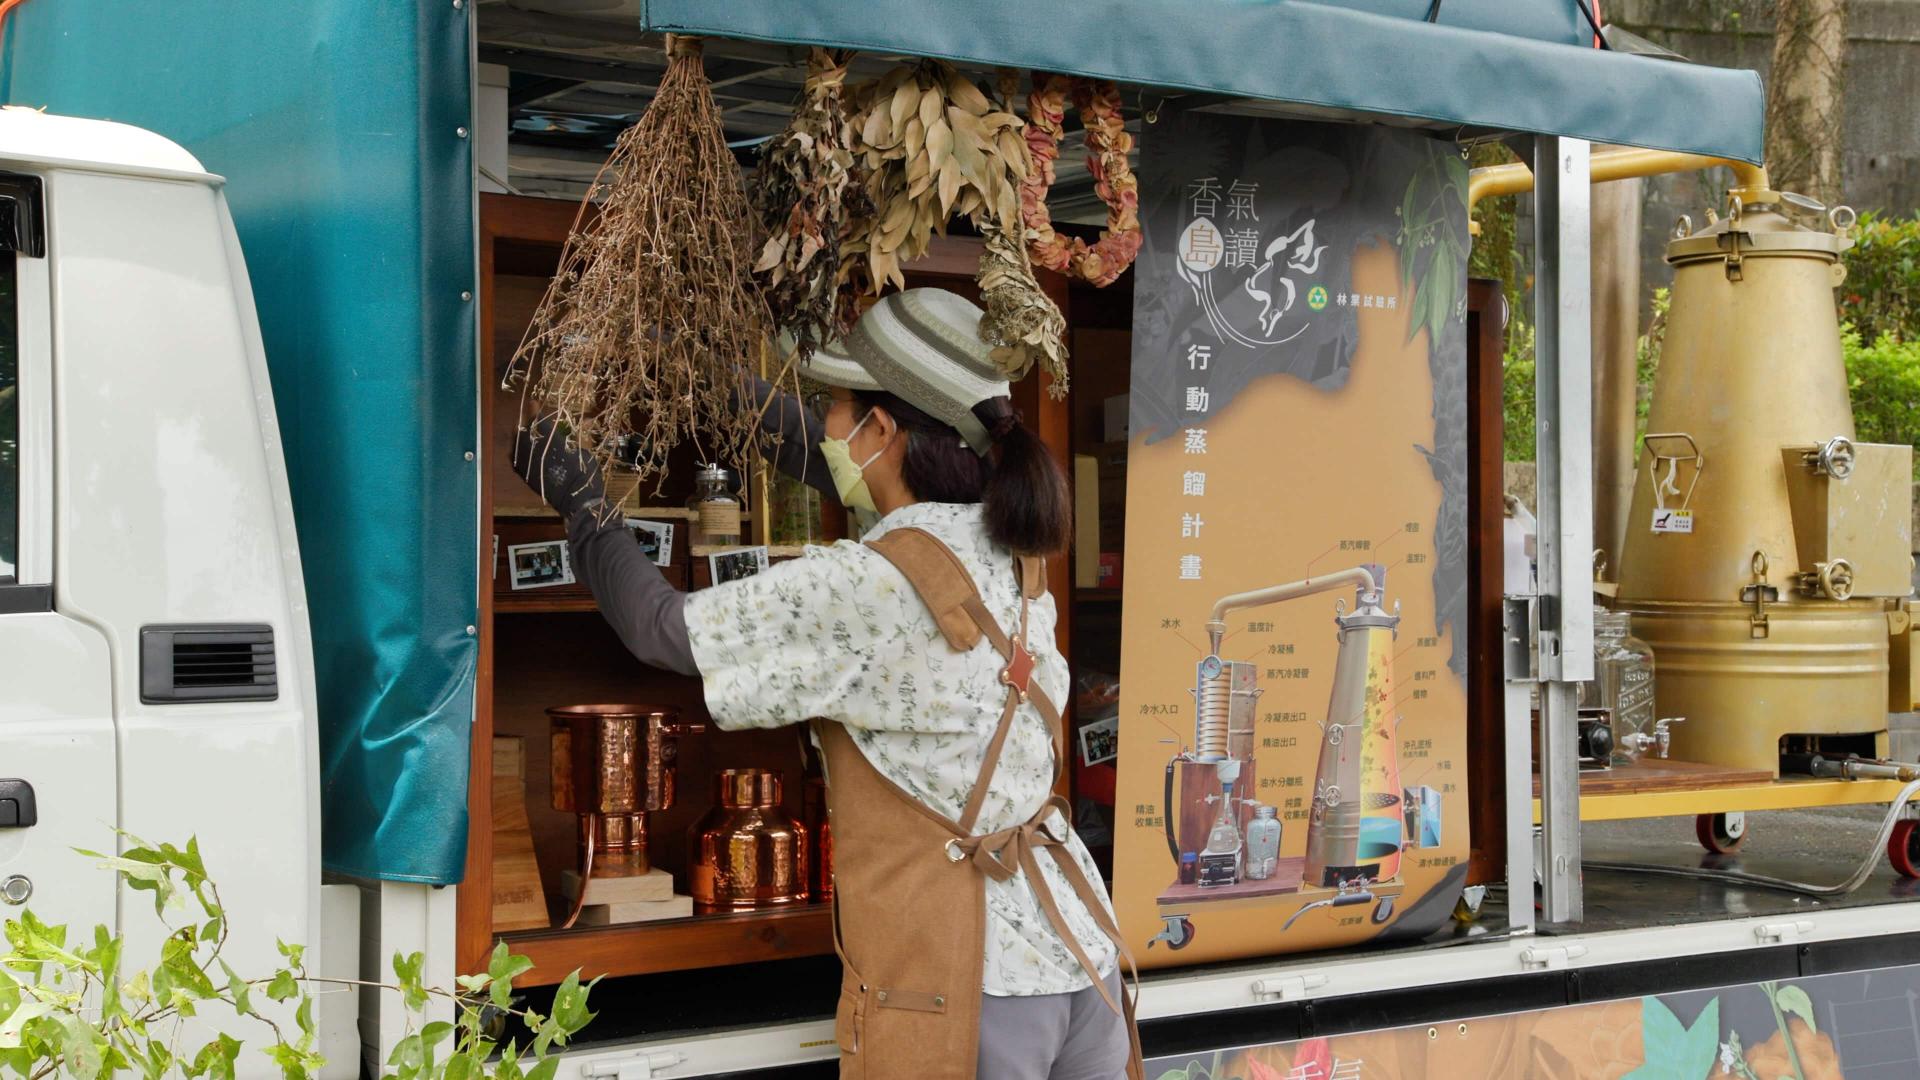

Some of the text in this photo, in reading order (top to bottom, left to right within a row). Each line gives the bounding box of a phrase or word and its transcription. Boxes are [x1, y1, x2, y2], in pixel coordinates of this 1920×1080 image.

[1187, 176, 1260, 222] 香氣
[1185, 224, 1259, 269] 島讀
[1179, 343, 1211, 580] 行動蒸餾計畫
[1161, 618, 1181, 629] 冰水
[1248, 622, 1275, 633] 溫度計
[1267, 644, 1295, 655] 冷凝桶
[1266, 668, 1310, 680] 蒸汽冷凝管
[1139, 704, 1179, 715] 冷水入口
[1263, 712, 1307, 723] 冷凝液出口
[1262, 737, 1297, 748] 精油出口
[1135, 804, 1155, 815] 精油
[1134, 816, 1164, 828] 收集瓶
